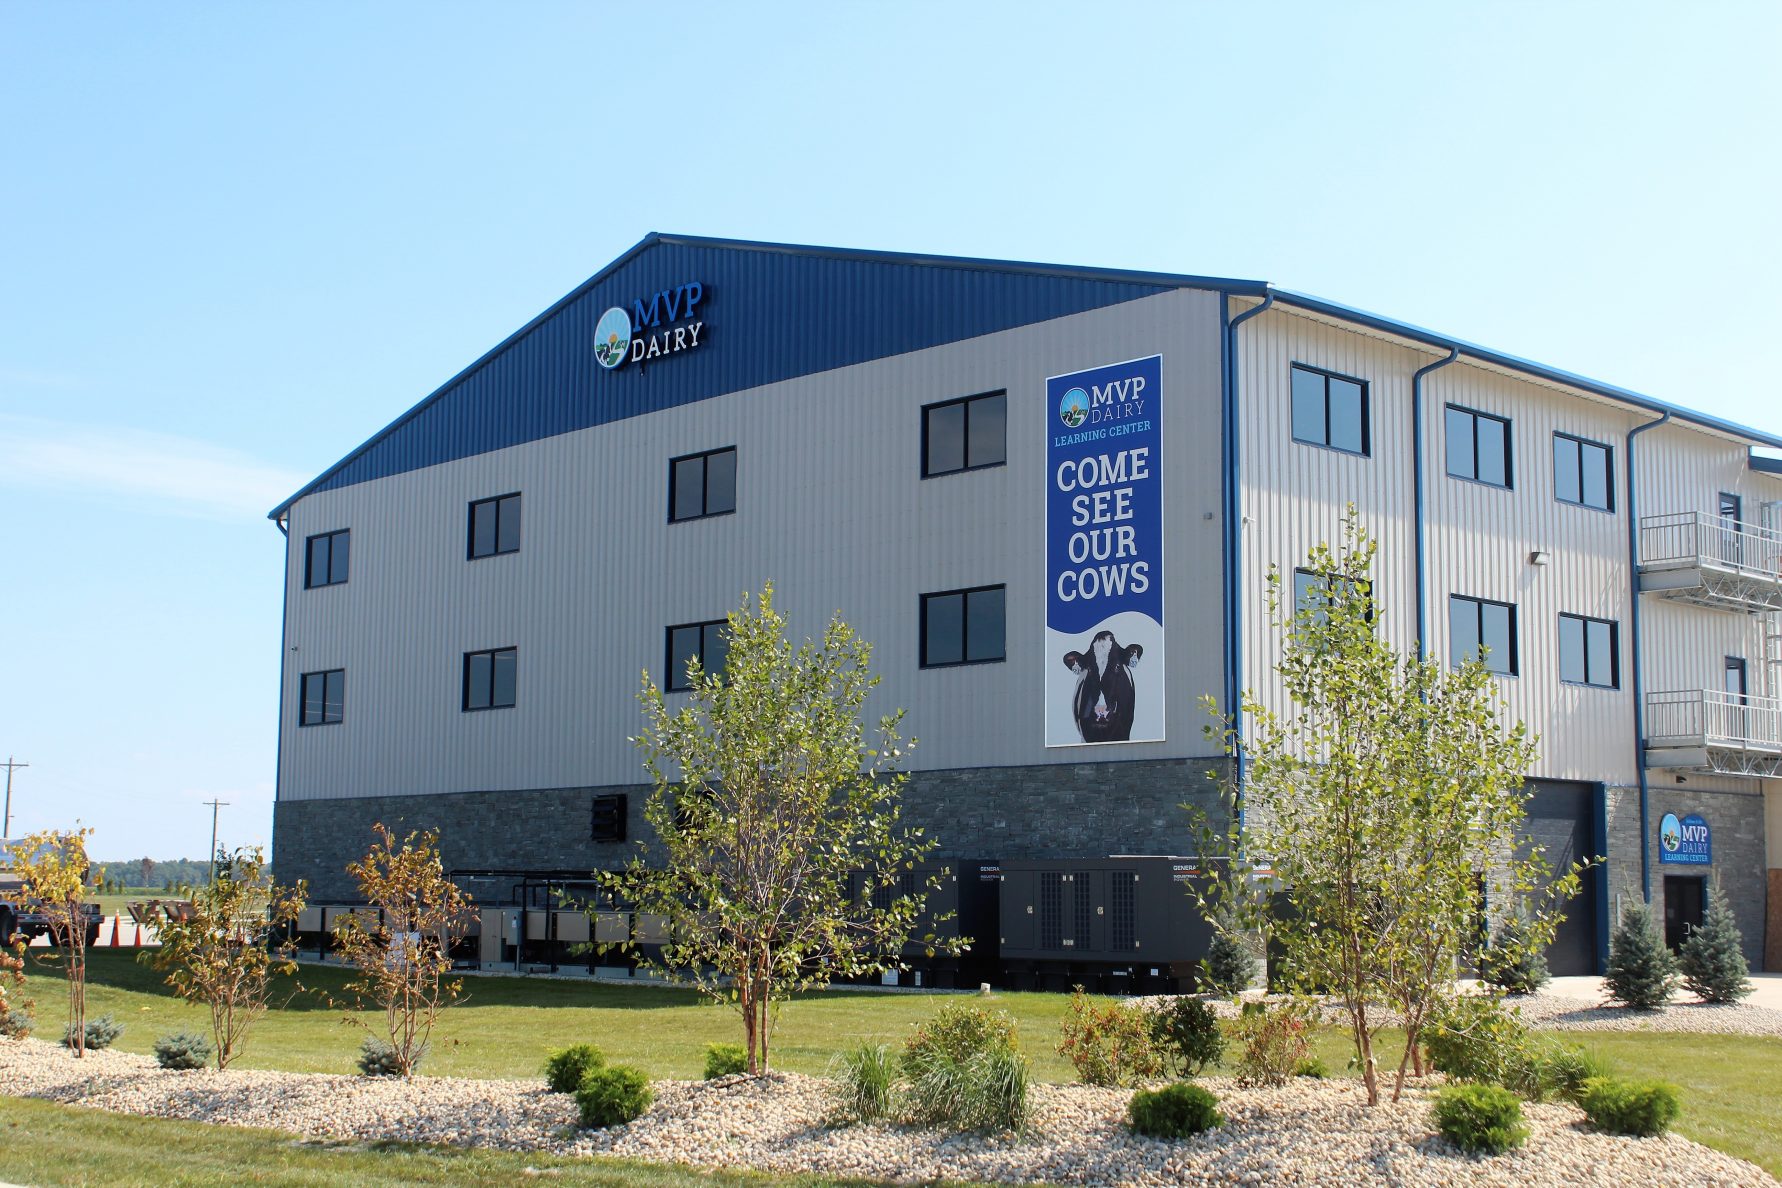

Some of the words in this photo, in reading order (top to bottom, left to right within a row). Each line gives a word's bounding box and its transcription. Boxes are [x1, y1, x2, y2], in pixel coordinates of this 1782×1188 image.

[633, 282, 703, 333] MVP
[631, 322, 703, 363] DAIRY
[1091, 376, 1146, 408] MVP
[1091, 400, 1145, 424] DAIRY
[1054, 428, 1107, 448] LEARNING
[1109, 420, 1151, 436] CENTER
[1057, 447, 1149, 492] COME
[1072, 487, 1133, 527] SEE
[1068, 525, 1138, 564] OUR
[1057, 561, 1149, 602] COWS
[1682, 825, 1708, 842] MVP
[1682, 842, 1708, 853] DAIRY
[1664, 853, 1690, 861] LEARNING
[1690, 854, 1708, 862] CENTER
